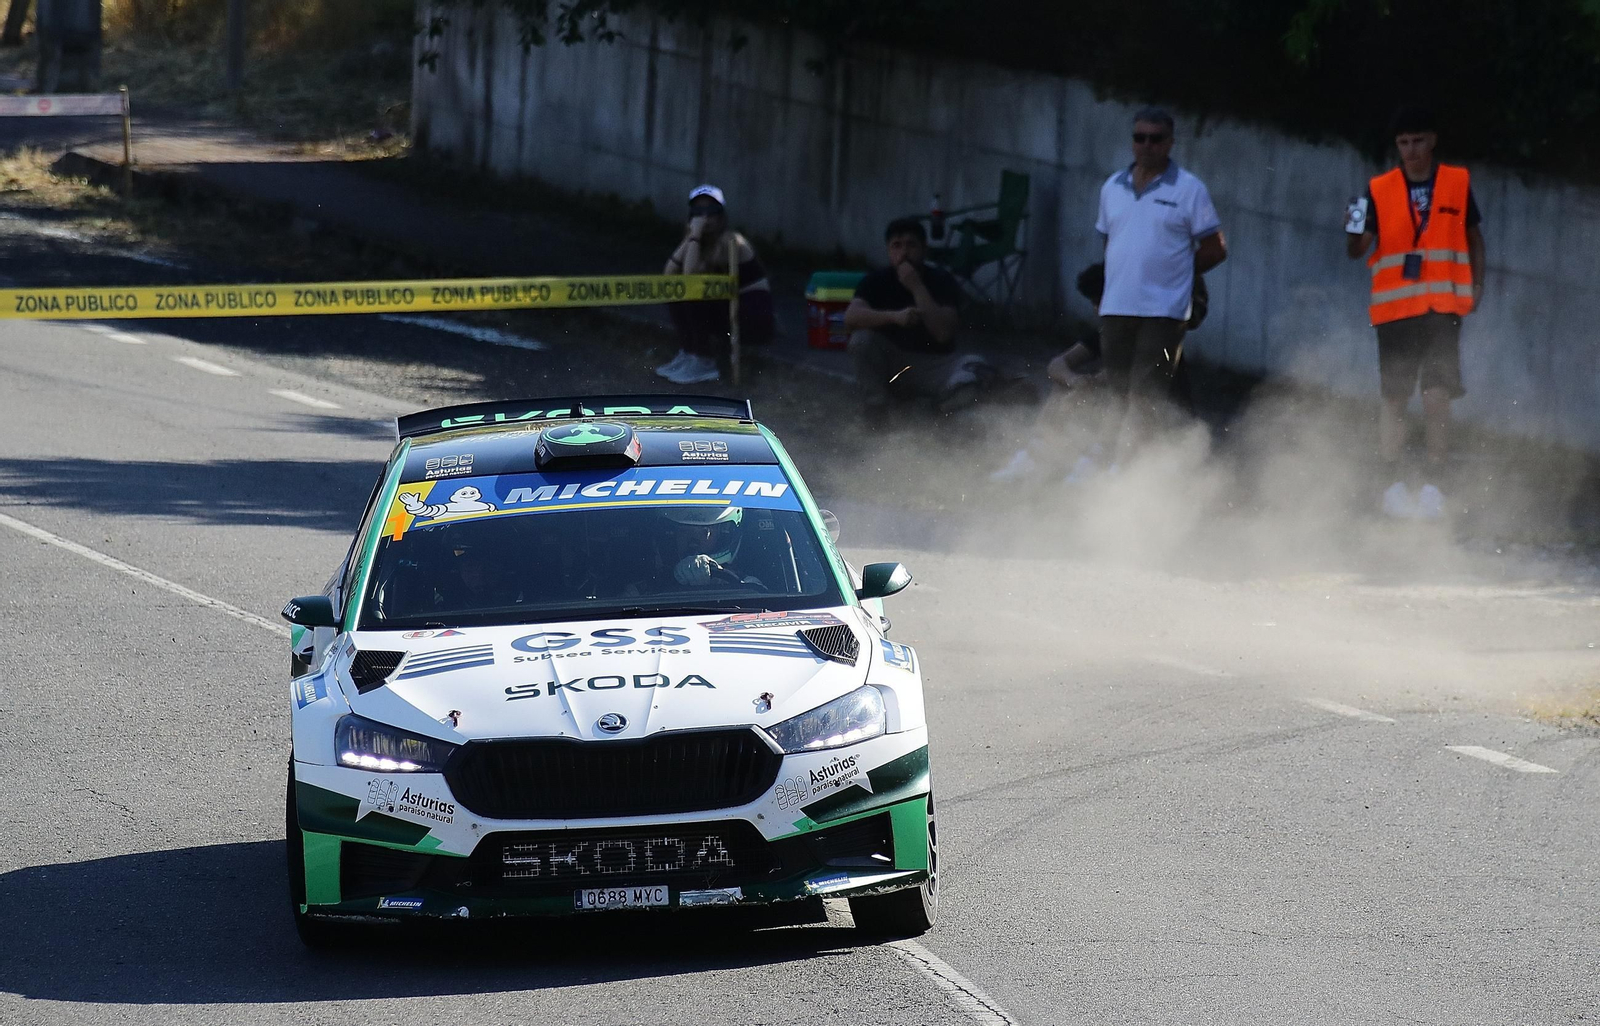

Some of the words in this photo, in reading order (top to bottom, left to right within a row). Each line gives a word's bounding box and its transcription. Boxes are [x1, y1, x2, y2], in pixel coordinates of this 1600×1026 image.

[15, 295, 61, 313] ZONA
[65, 294, 138, 312] PUBLICO
[156, 293, 200, 310] ZONA
[205, 291, 277, 310] PUBLICO
[294, 289, 339, 307] ZONA
[343, 288, 415, 306] PUBLICO
[432, 287, 475, 305] ZONA
[480, 285, 550, 303] PUBLICO
[567, 283, 609, 300] ZONA
[616, 281, 686, 300] PUBLICO
[426, 466, 472, 476] Asturias
[503, 479, 789, 504] MICHELIN
[387, 511, 407, 541] 1
[510, 626, 691, 653] GSS
[513, 650, 592, 664] Subsea
[601, 647, 692, 656] Services
[504, 673, 717, 701] SKODA
[809, 755, 856, 786] Asturias
[837, 766, 860, 783] natural
[400, 787, 455, 815] Asturias
[426, 811, 454, 824] natural
[502, 835, 736, 878] SKODA
[818, 876, 848, 885] MICHELIN
[587, 890, 627, 905] 0688
[633, 888, 663, 904] MYC
